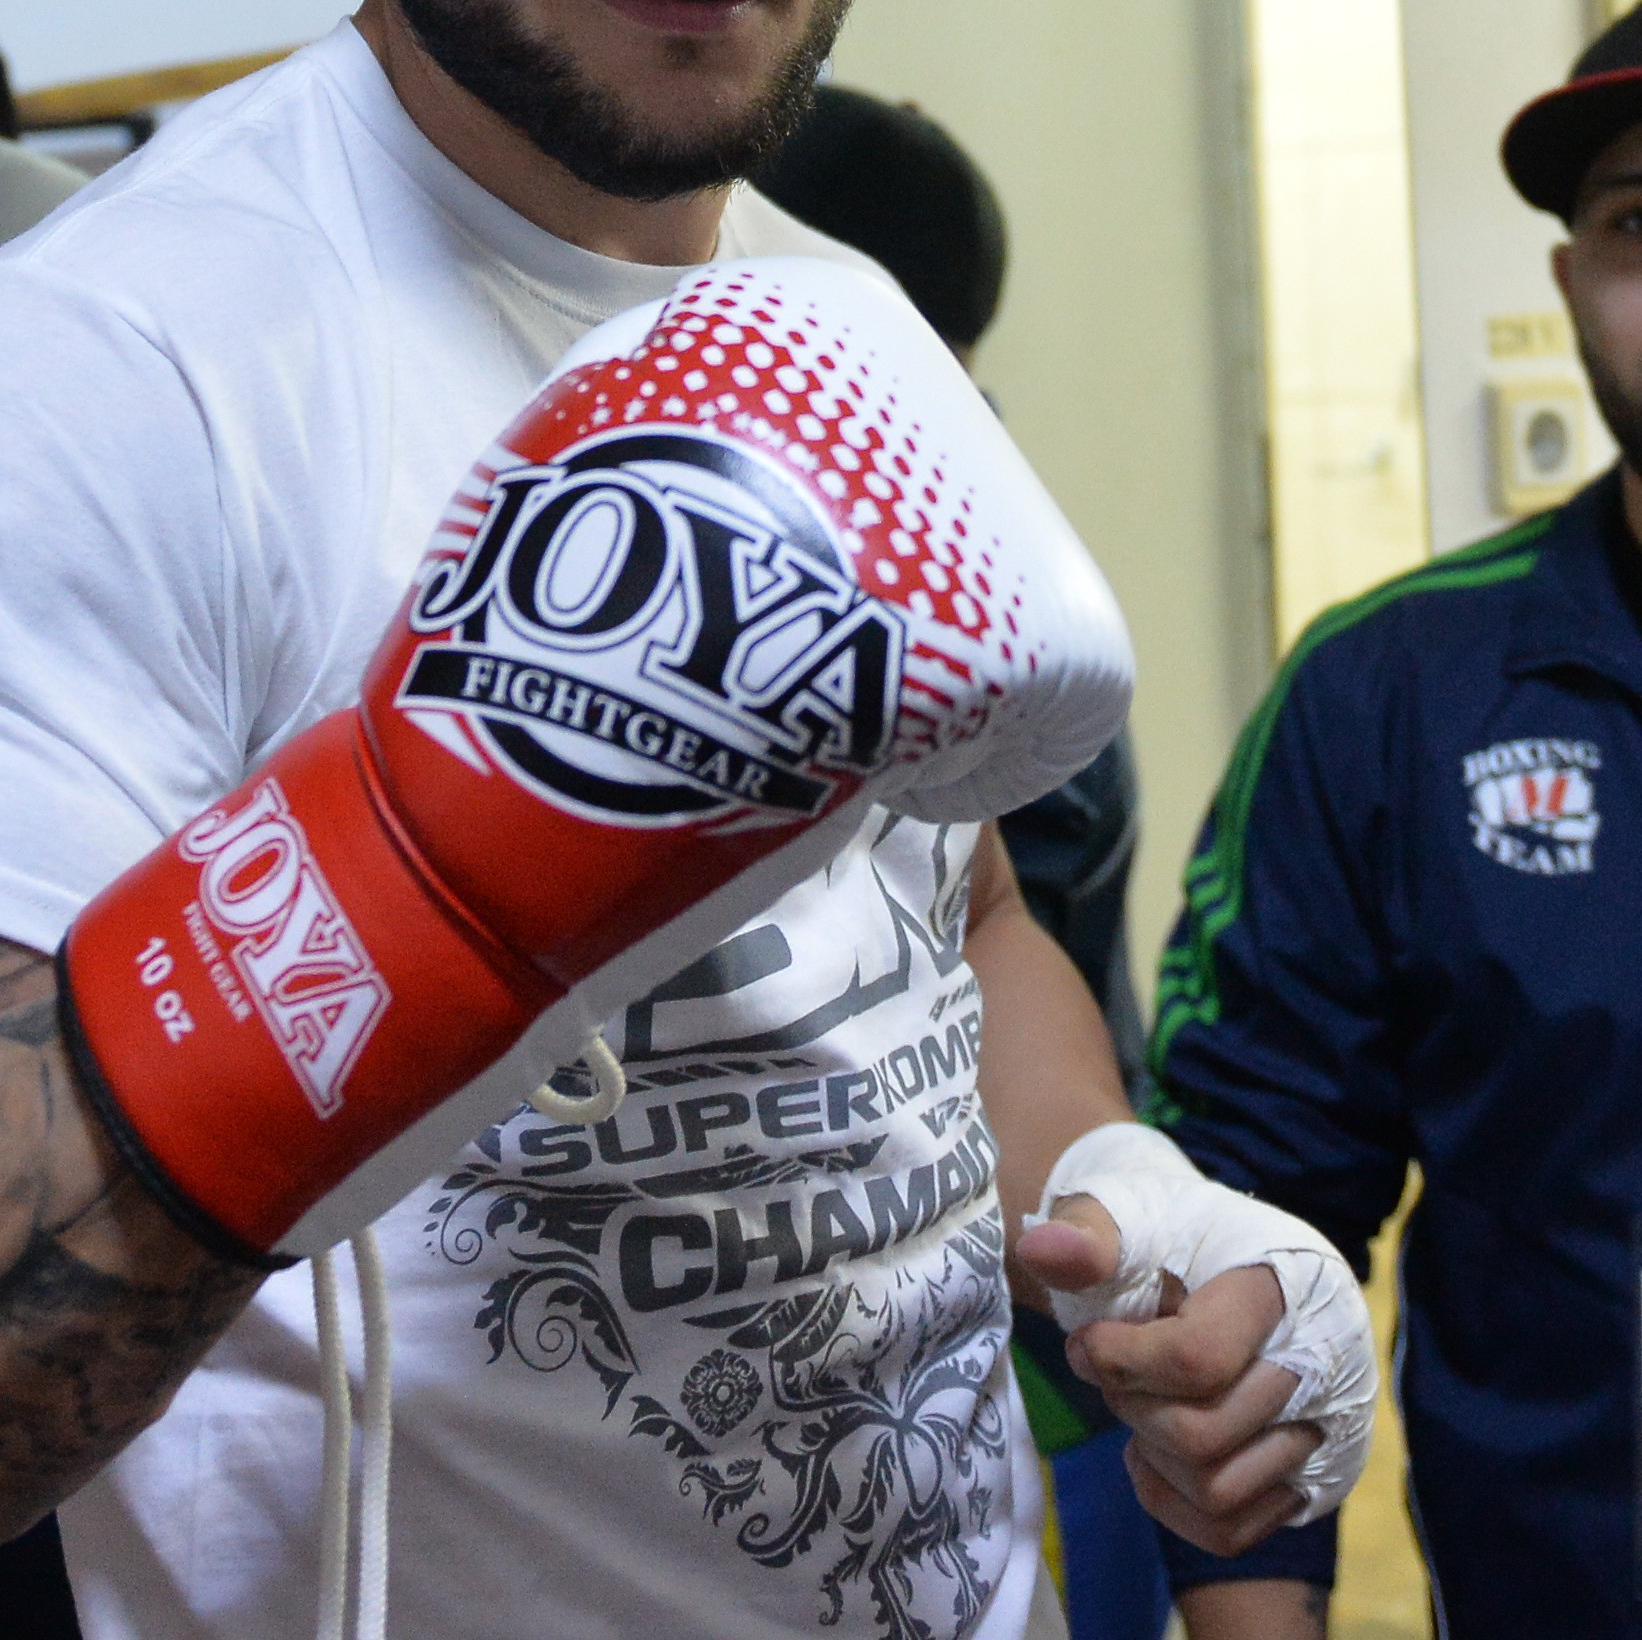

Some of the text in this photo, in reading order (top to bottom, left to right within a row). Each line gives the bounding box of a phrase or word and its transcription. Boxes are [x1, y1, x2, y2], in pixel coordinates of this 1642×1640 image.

[408, 465, 906, 776] JOYA
[462, 658, 772, 800] FIGHTGEAR
[1462, 737, 1603, 787] BOXING
[1467, 812, 1595, 875] TEAM
[134, 937, 174, 987] 10
[177, 777, 393, 1120] JOYA
